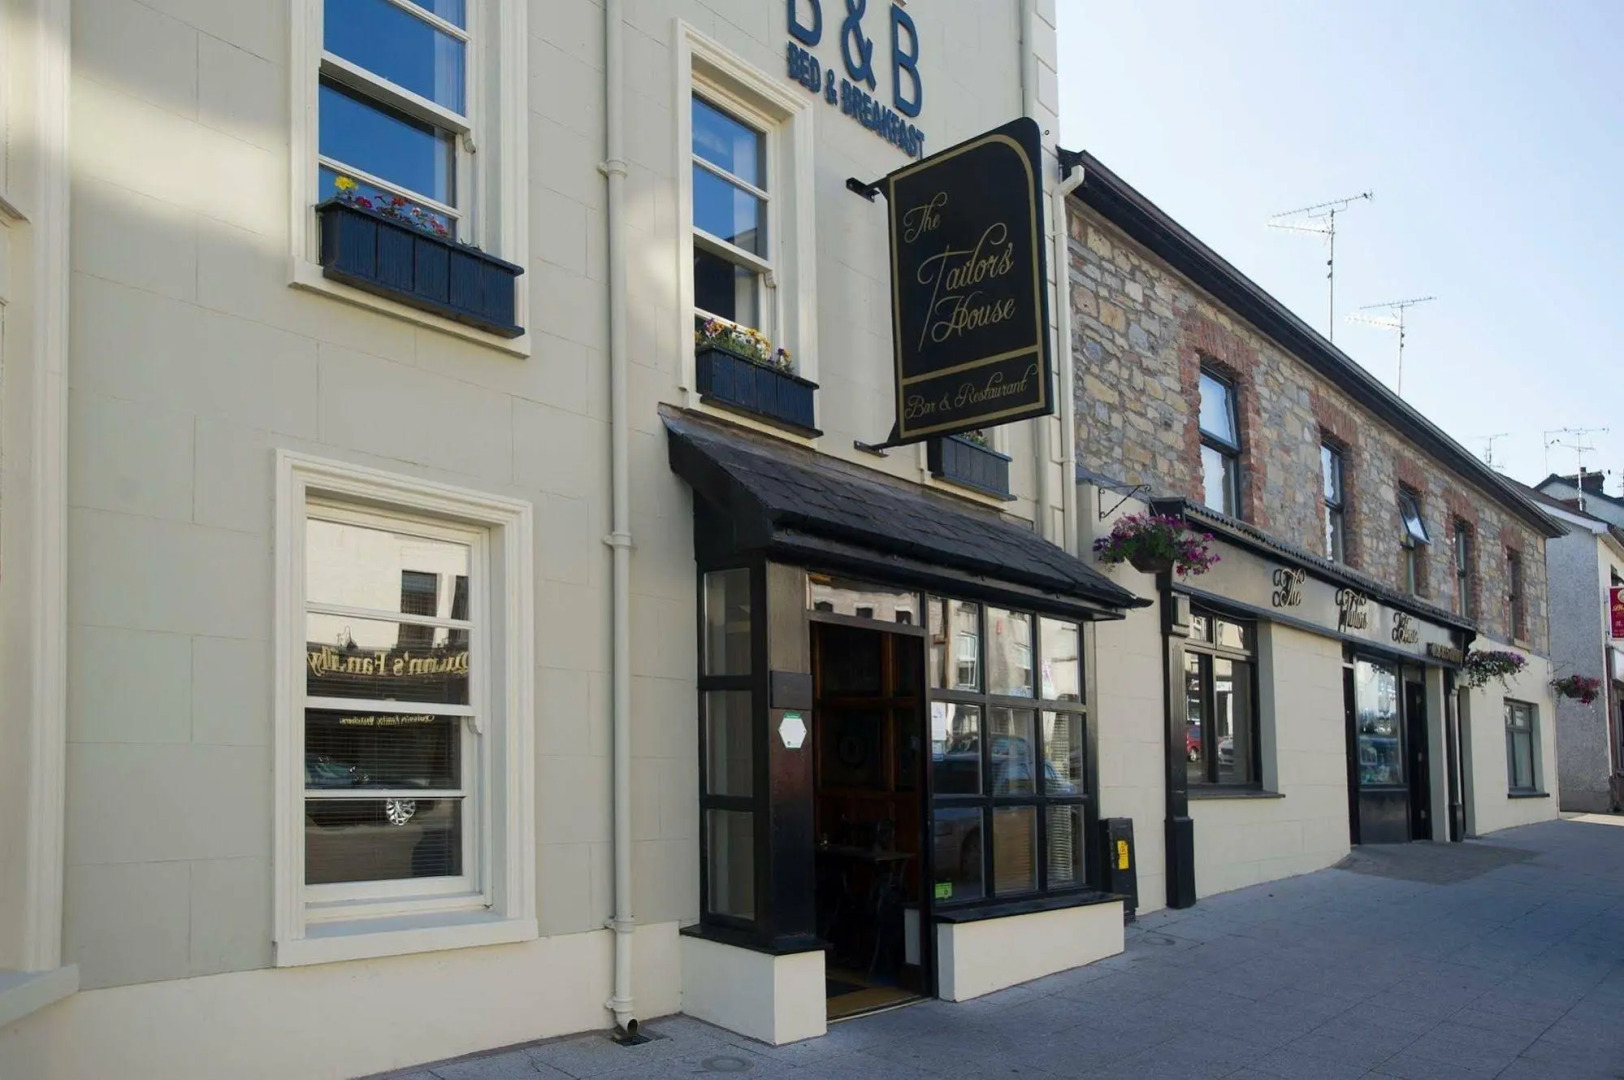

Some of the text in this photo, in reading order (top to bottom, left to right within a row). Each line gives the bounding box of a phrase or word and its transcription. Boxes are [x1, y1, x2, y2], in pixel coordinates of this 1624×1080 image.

[891, 2, 923, 118] B
[786, 41, 925, 161] BED & BREAKFAST
[903, 191, 949, 244] The
[931, 291, 1016, 343] House
[904, 362, 1039, 420] Bar & Restaurant
